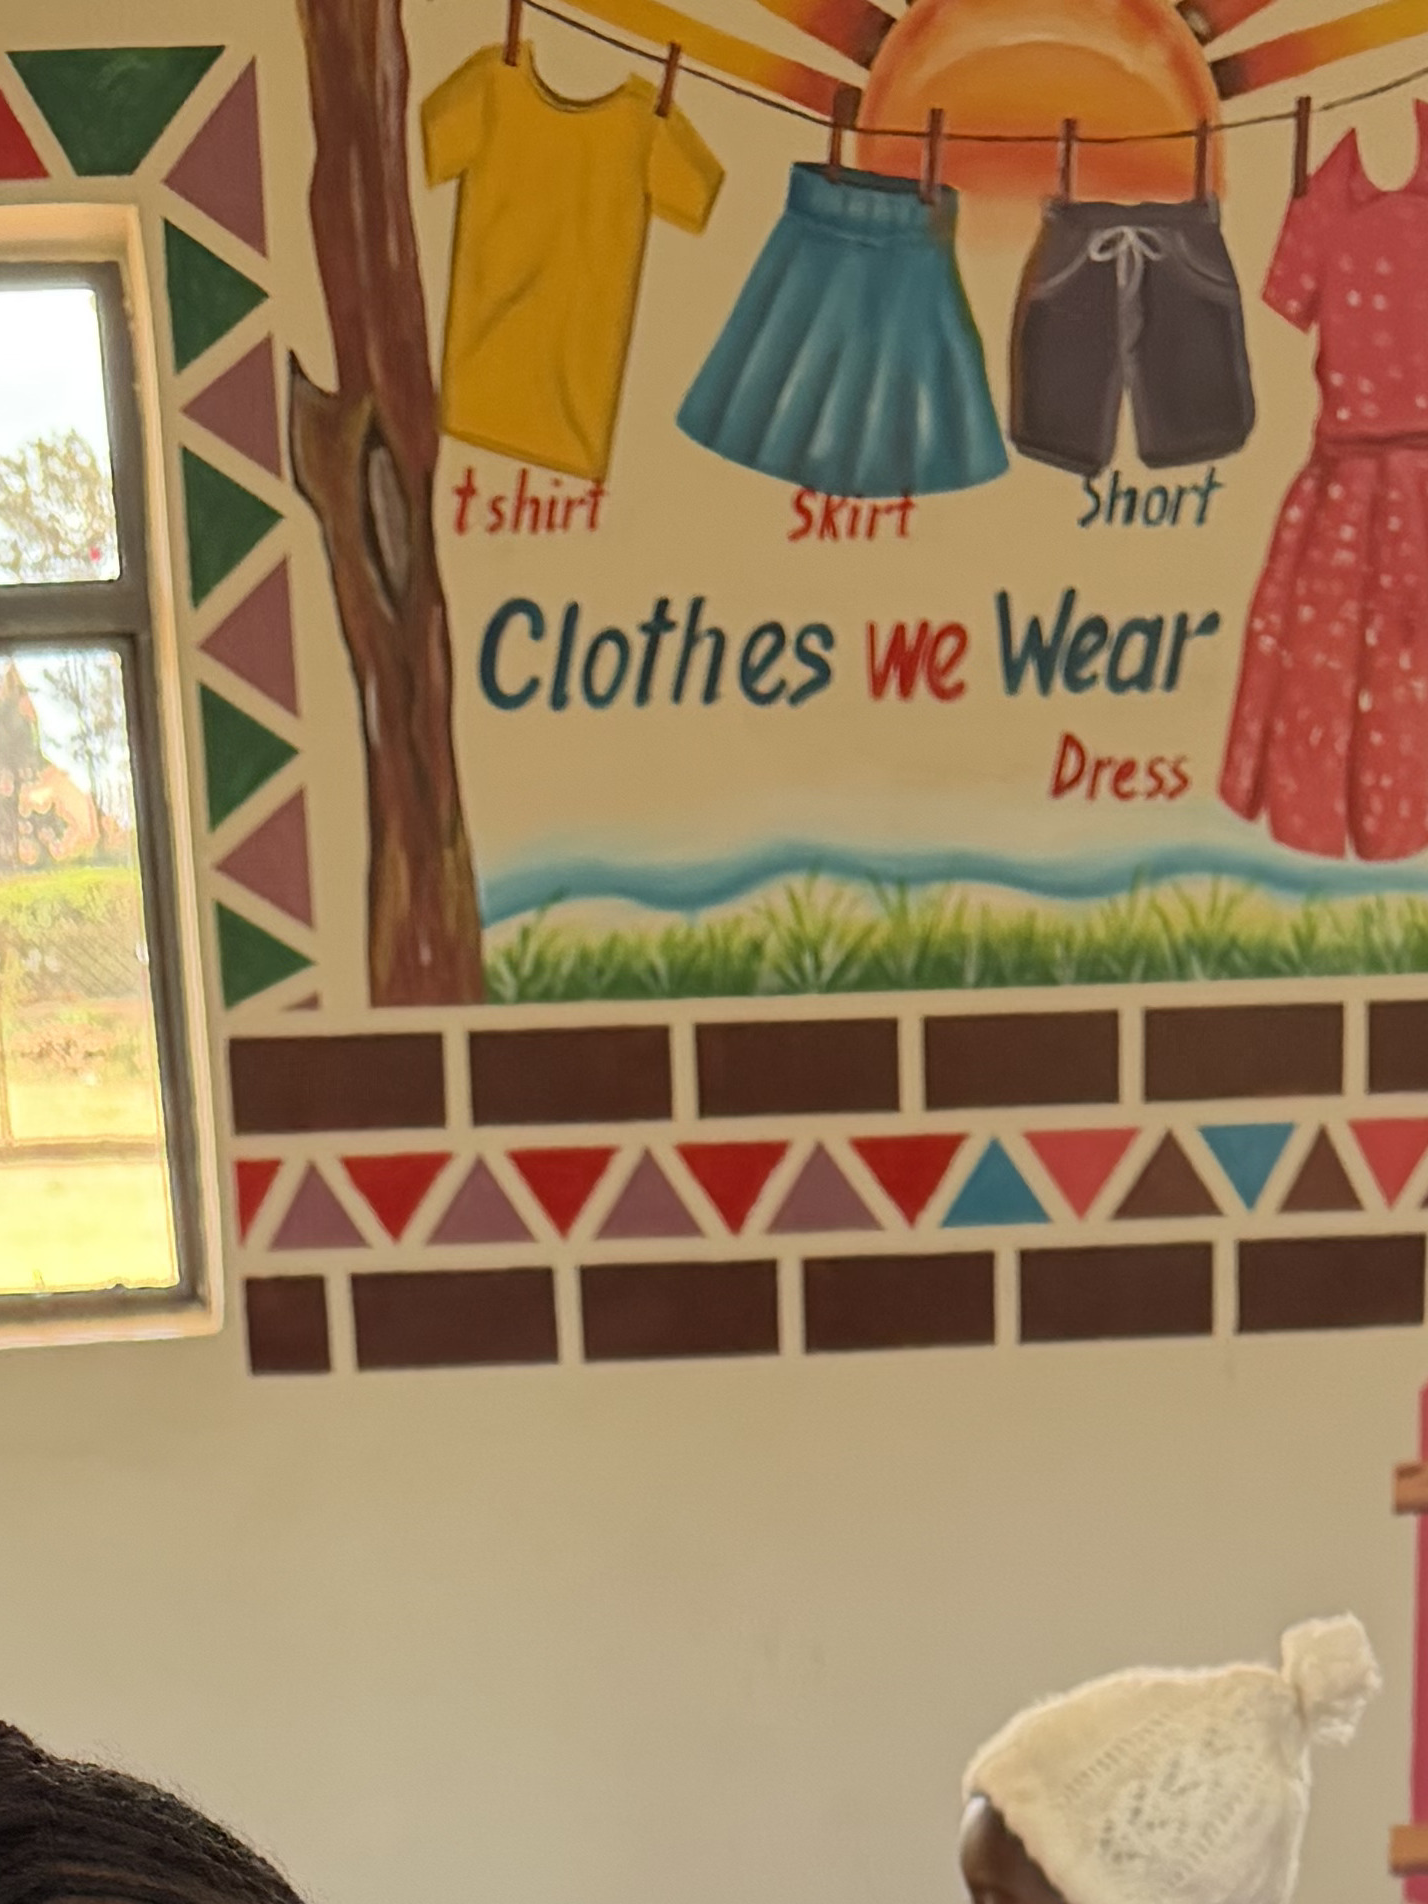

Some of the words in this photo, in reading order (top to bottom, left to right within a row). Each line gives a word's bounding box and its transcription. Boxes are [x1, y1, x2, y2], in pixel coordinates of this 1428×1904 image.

[1077, 466, 1226, 528] Short
[479, 596, 836, 712] Clothes
[866, 619, 968, 702] we
[994, 586, 1222, 697] Wear
[1048, 731, 1192, 801] Dress
